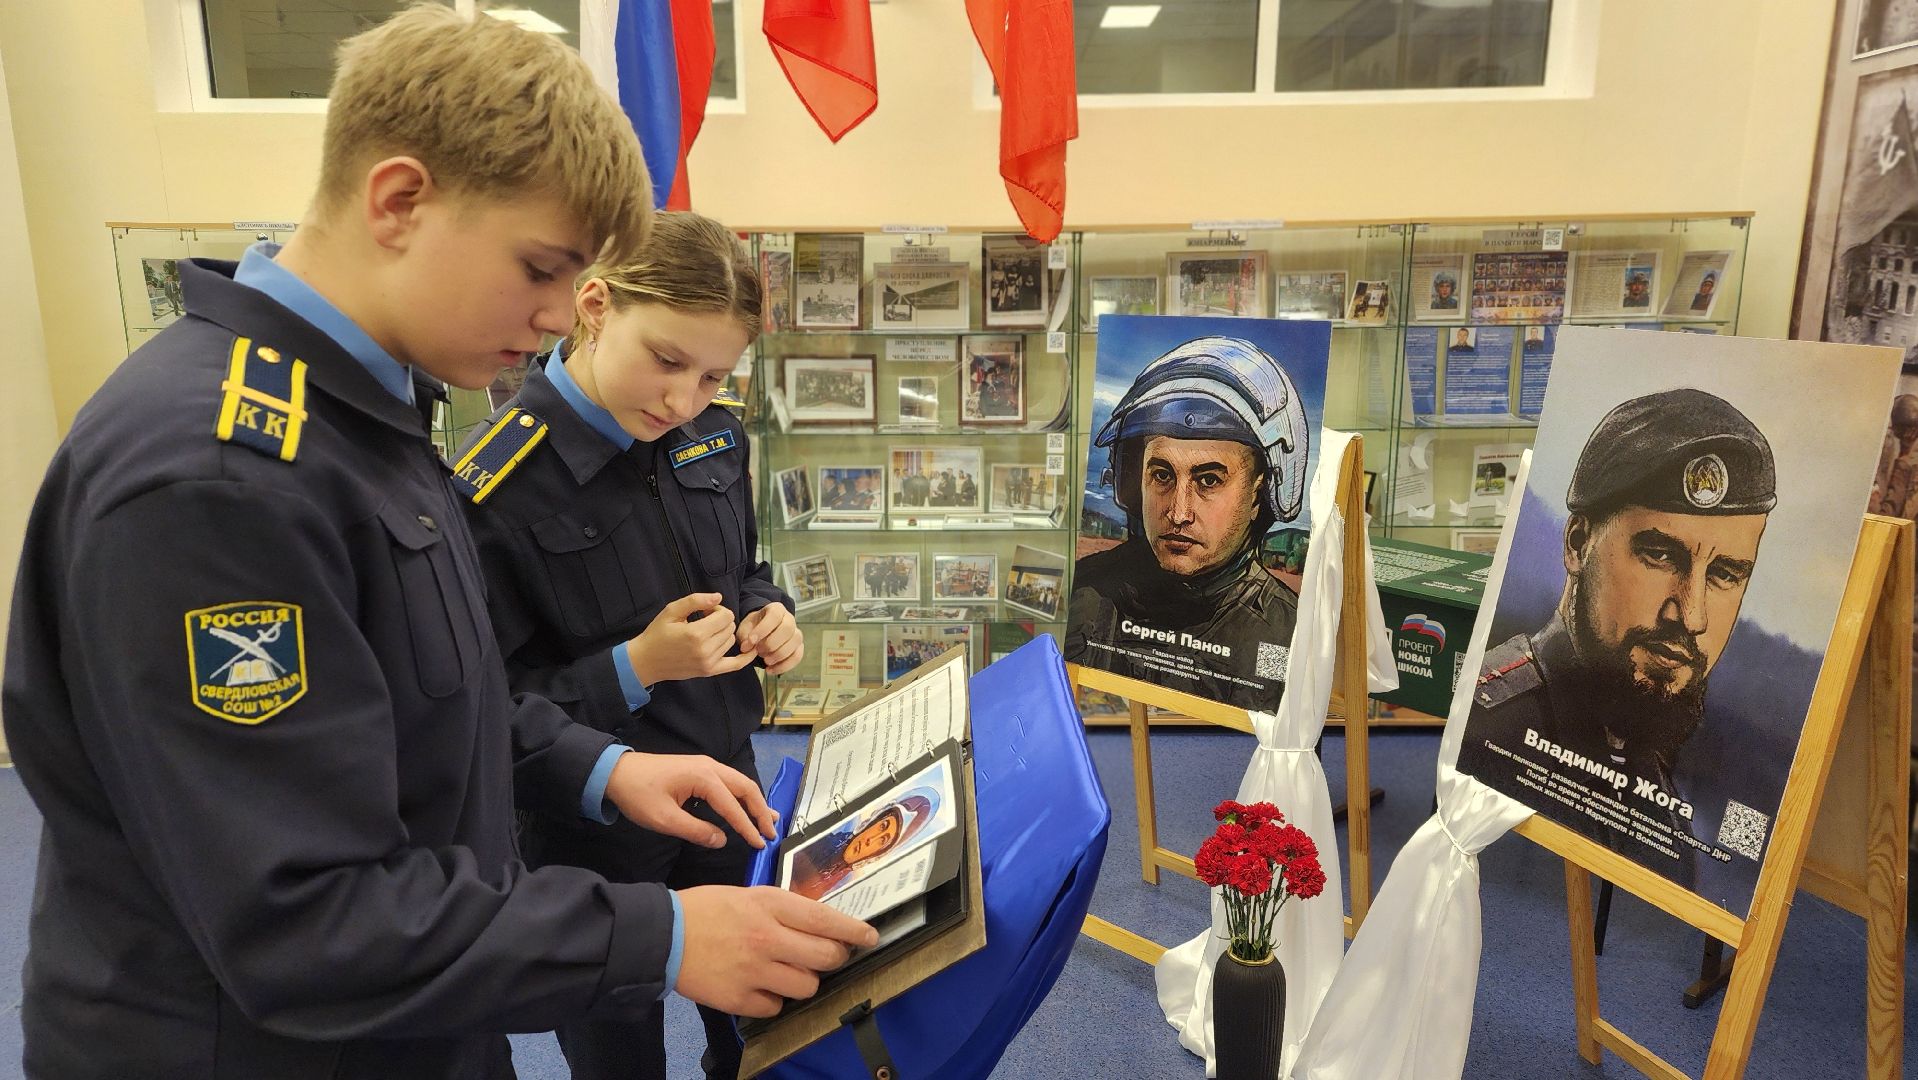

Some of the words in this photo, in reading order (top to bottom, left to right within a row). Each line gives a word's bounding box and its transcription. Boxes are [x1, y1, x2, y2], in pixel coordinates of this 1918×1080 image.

[199, 608, 290, 630] РОССИЯ
[1121, 620, 1176, 644] Сергей
[1180, 632, 1231, 657] Панов
[1398, 638, 1435, 655] ПРОЕКТ
[1397, 649, 1432, 666] НОВАЯ
[1397, 661, 1434, 679] ШКОЛА
[200, 672, 300, 702] СВЕРДЛОВСКАЯ
[223, 700, 257, 714] СОШ
[1523, 728, 1629, 790] Владимир
[1632, 775, 1694, 821] Жога
[1484, 739, 1513, 758] Гвардии
[1512, 753, 1550, 777] полковник,
[1550, 772, 1591, 796] разведчик,
[1591, 790, 1629, 814] командир
[1629, 807, 1673, 834] батальона
[1673, 830, 1711, 853] «Спарта»
[1711, 847, 1732, 863] ДНР
[1526, 768, 1548, 784] Погиб
[1547, 780, 1558, 789] во
[1558, 785, 1581, 801] время
[1581, 796, 1631, 824] обеспечения
[1631, 820, 1673, 846] эвакуации
[1516, 774, 1544, 793] мирных
[1543, 788, 1575, 808] жителей
[1575, 803, 1584, 812] из
[1584, 806, 1628, 834] Мариуполя
[1628, 829, 1635, 837] и
[1635, 831, 1681, 860] Волновахи
